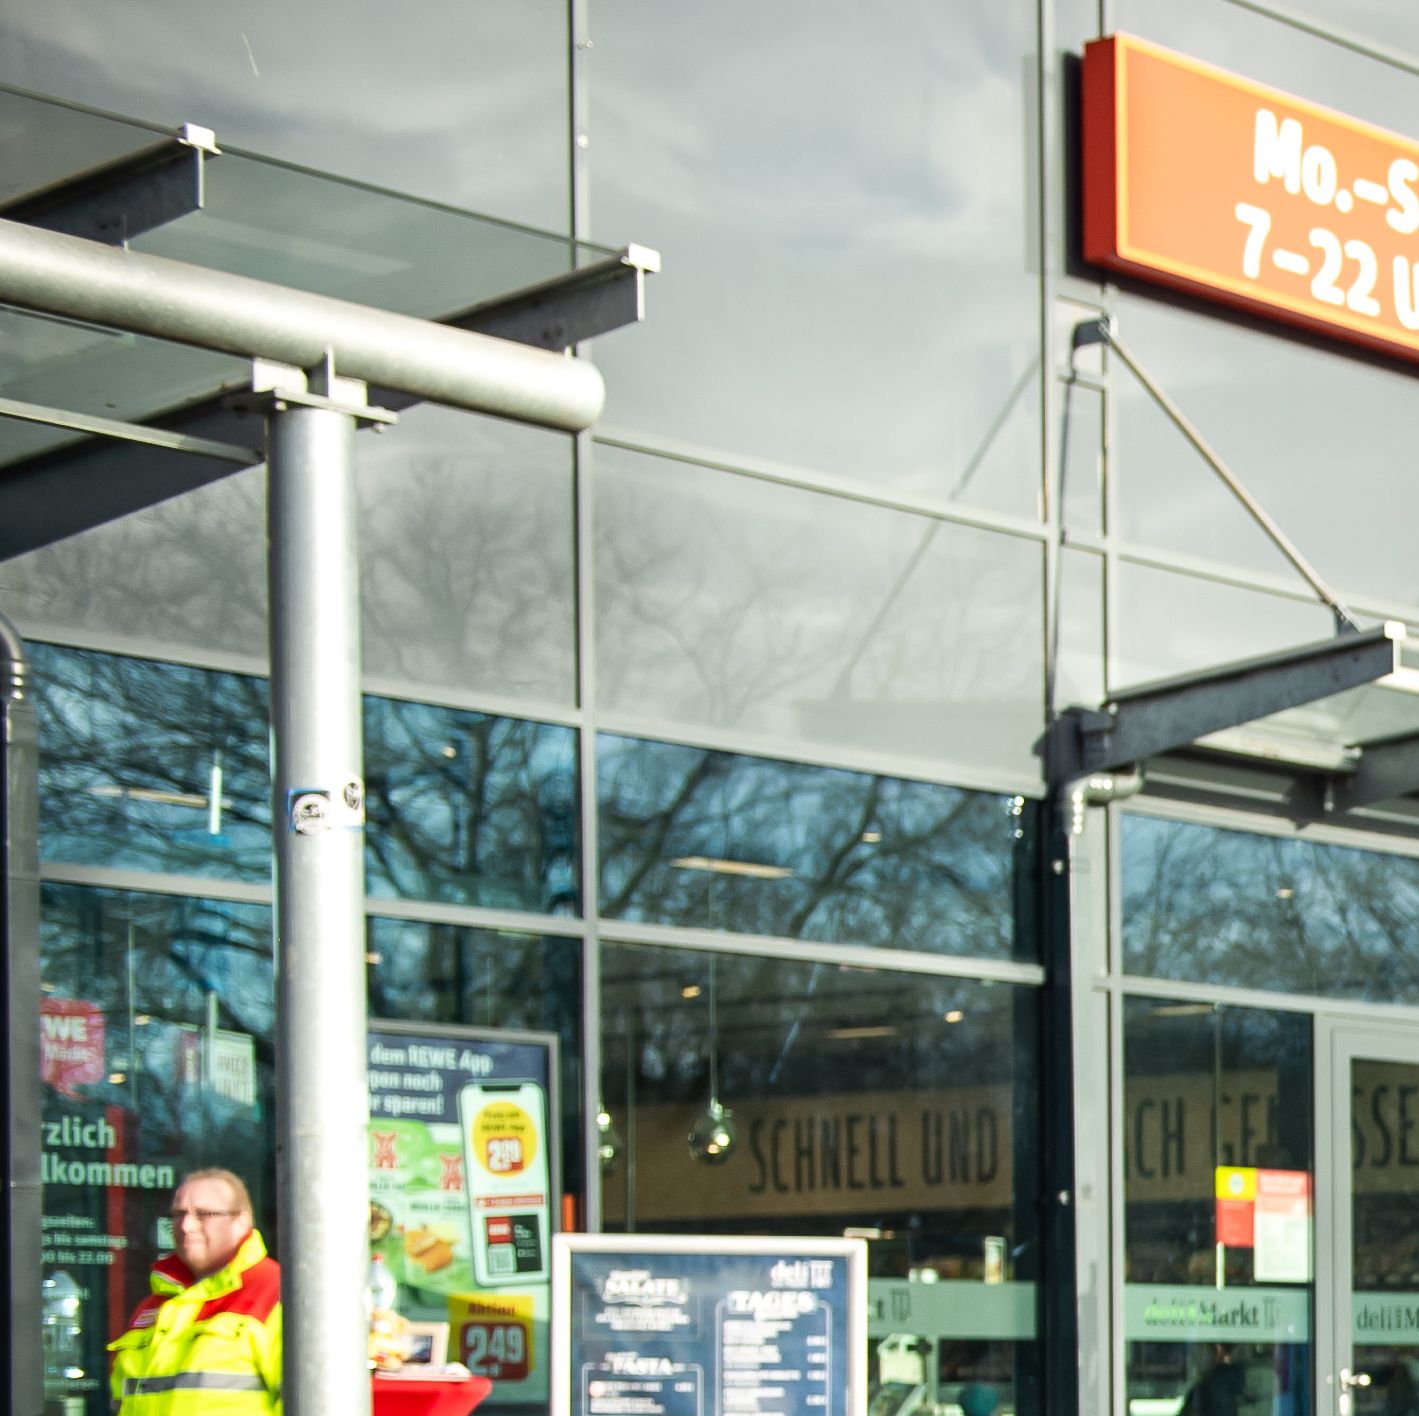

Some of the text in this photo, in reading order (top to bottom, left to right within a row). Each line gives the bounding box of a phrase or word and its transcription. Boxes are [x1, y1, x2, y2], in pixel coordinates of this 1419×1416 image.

[370, 1042, 495, 1078] dem REWE App
[403, 1070, 443, 1093] noch
[41, 1114, 117, 1150] zlich
[749, 1106, 998, 1194] SCHNELL UND
[1199, 1299, 1259, 1328] Markt
